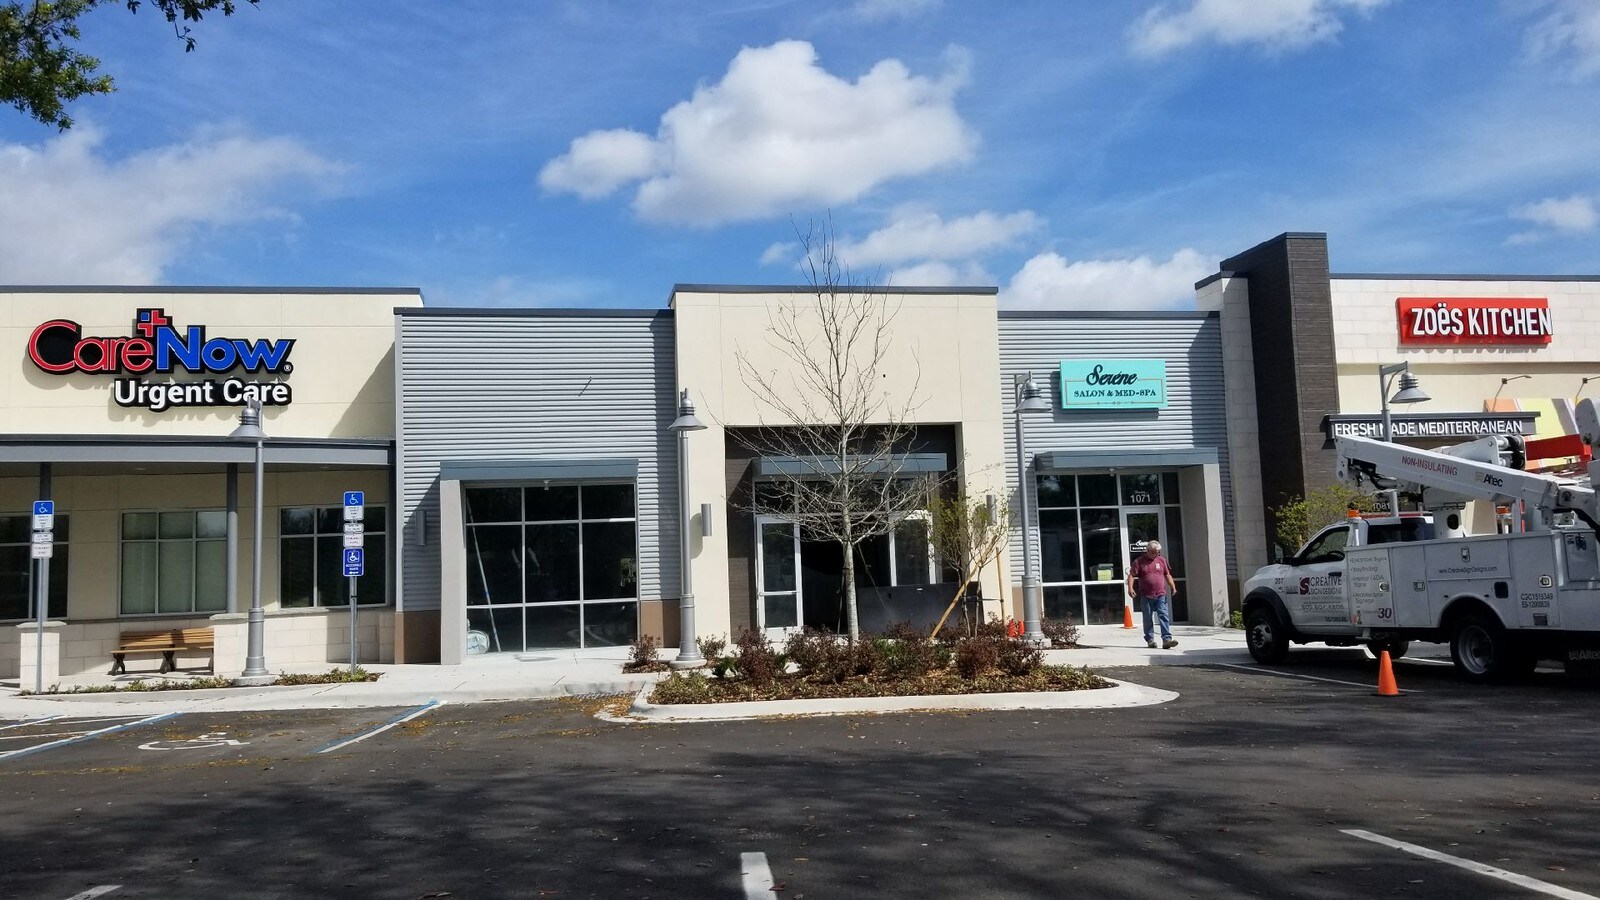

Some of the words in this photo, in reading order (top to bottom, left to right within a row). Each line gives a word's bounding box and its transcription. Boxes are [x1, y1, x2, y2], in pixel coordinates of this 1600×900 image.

[1467, 307, 1553, 336] KITCHEN
[1086, 364, 1138, 386] Serene
[115, 378, 214, 409] Urgent
[223, 379, 289, 403] Care
[1074, 389, 1105, 398] SALON
[1106, 389, 1114, 397] &
[1115, 388, 1156, 397] MED-SPA
[1334, 422, 1376, 437] FRESH
[1418, 420, 1523, 436] MEDITERRANEAN
[1401, 455, 1458, 477] NON-INSULATING
[1483, 472, 1504, 488] Altec
[1130, 493, 1151, 504] 1071
[1310, 576, 1342, 587] CREATIVE
[1378, 607, 1393, 619] 30
